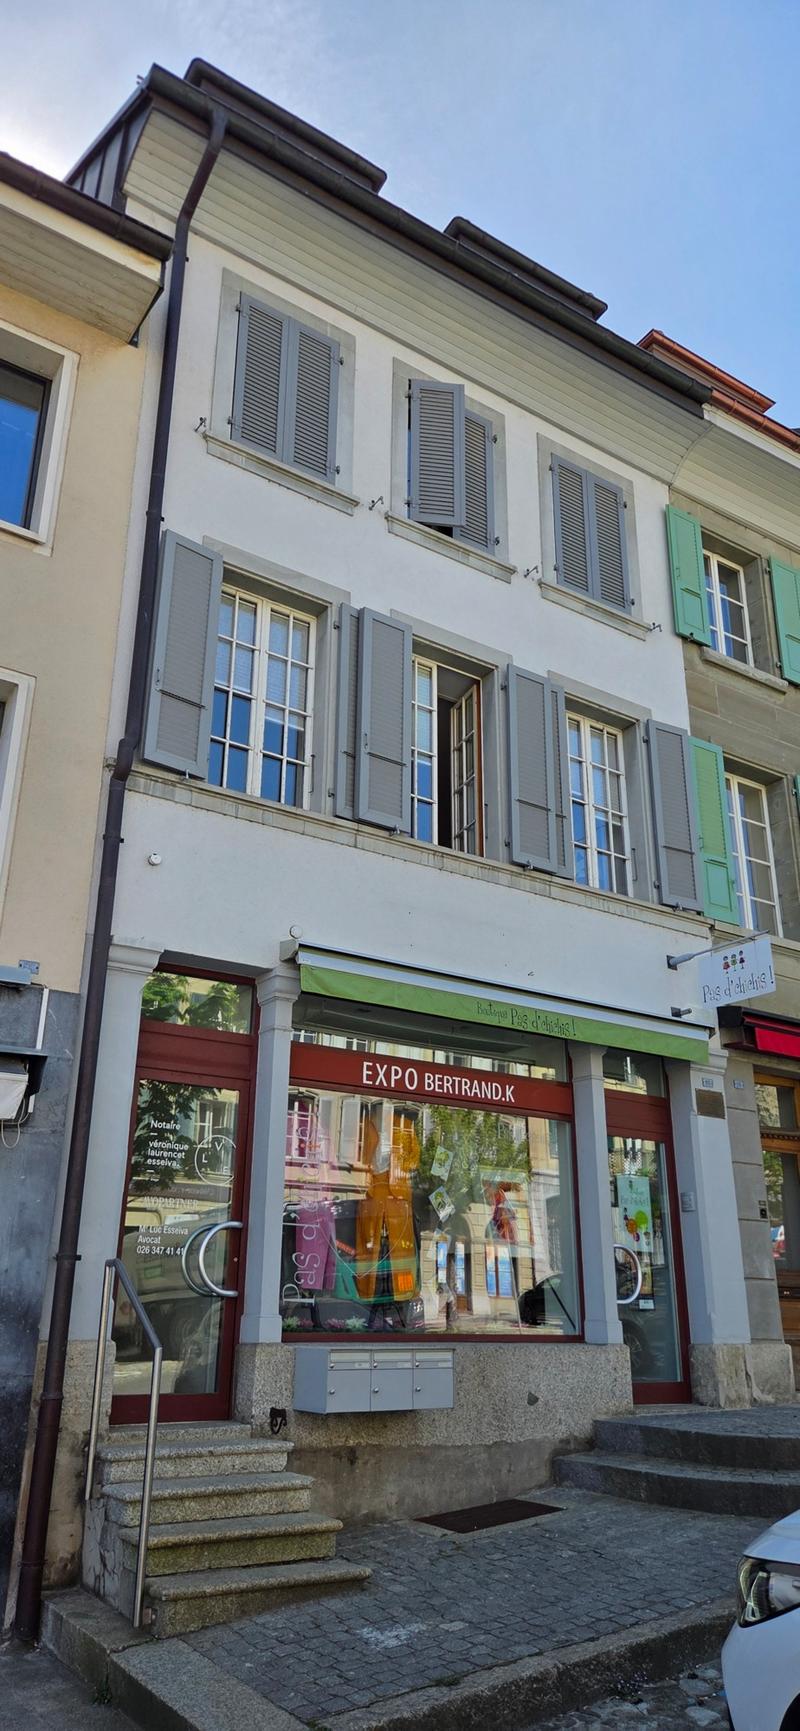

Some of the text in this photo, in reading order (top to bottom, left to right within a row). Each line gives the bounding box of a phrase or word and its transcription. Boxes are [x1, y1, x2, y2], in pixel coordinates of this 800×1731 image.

[702, 984, 722, 1003] Pas
[510, 1007, 528, 1030] Pas
[362, 1061, 515, 1103] EXPO BERTRAND.K
[150, 1119, 181, 1130] Notaire
[148, 1139, 189, 1151] véronique
[147, 1148, 185, 1159] laurencet
[149, 1225, 163, 1234] Luc
[163, 1226, 189, 1235] Esseiva
[137, 1235, 161, 1245] Avocat
[136, 1245, 150, 1254] 026
[151, 1246, 164, 1255] 347
[165, 1246, 174, 1256] 41
